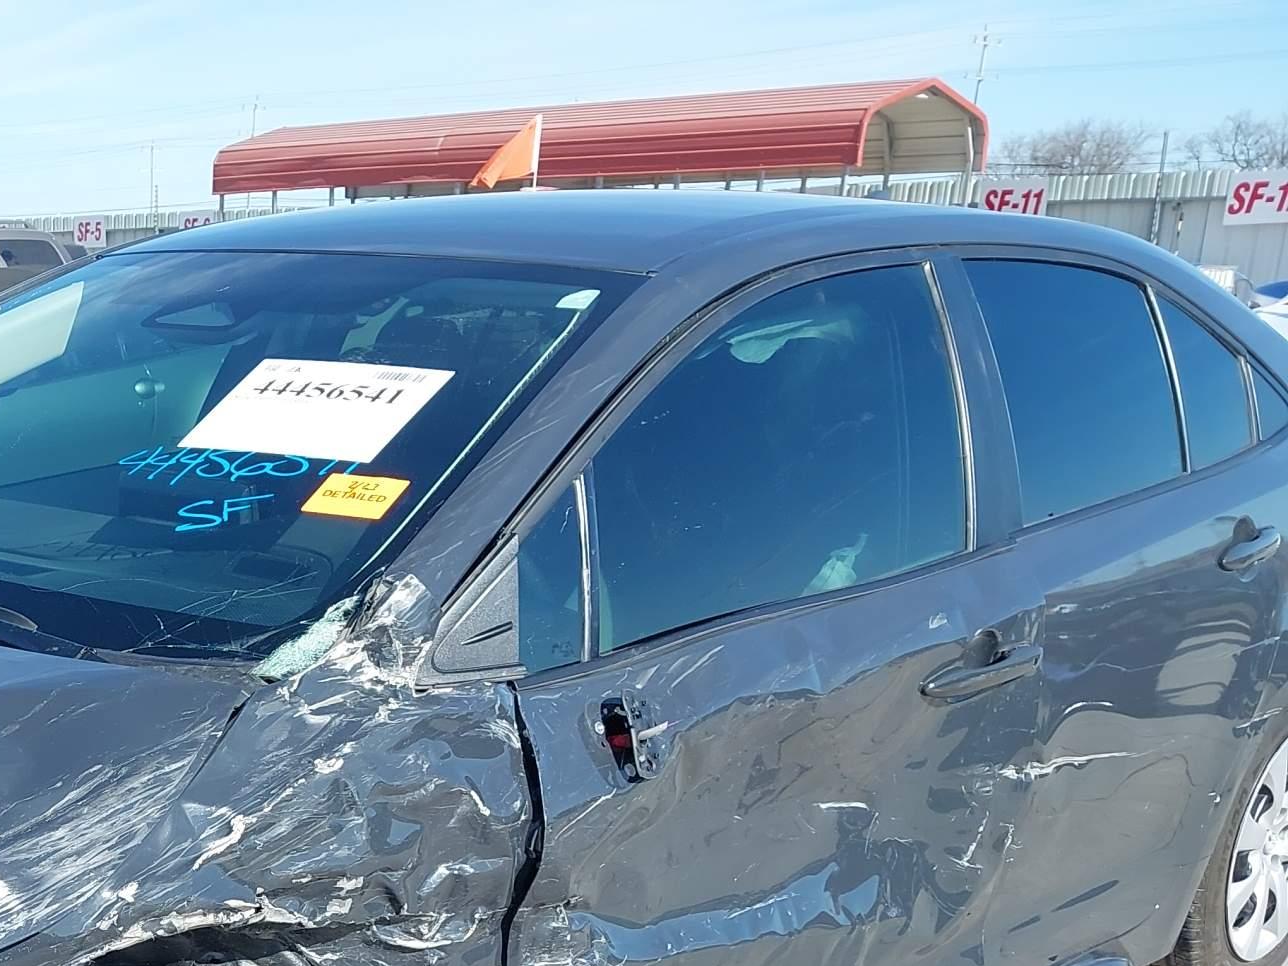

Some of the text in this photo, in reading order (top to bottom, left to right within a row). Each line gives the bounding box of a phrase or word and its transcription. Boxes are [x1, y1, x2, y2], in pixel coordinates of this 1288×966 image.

[984, 188, 1045, 216] SF-11
[1227, 180, 1288, 215] SF-1
[77, 221, 102, 242] SF-5
[253, 379, 405, 404] 44456541
[322, 489, 387, 503] DETAILED
[175, 493, 275, 532] SF
